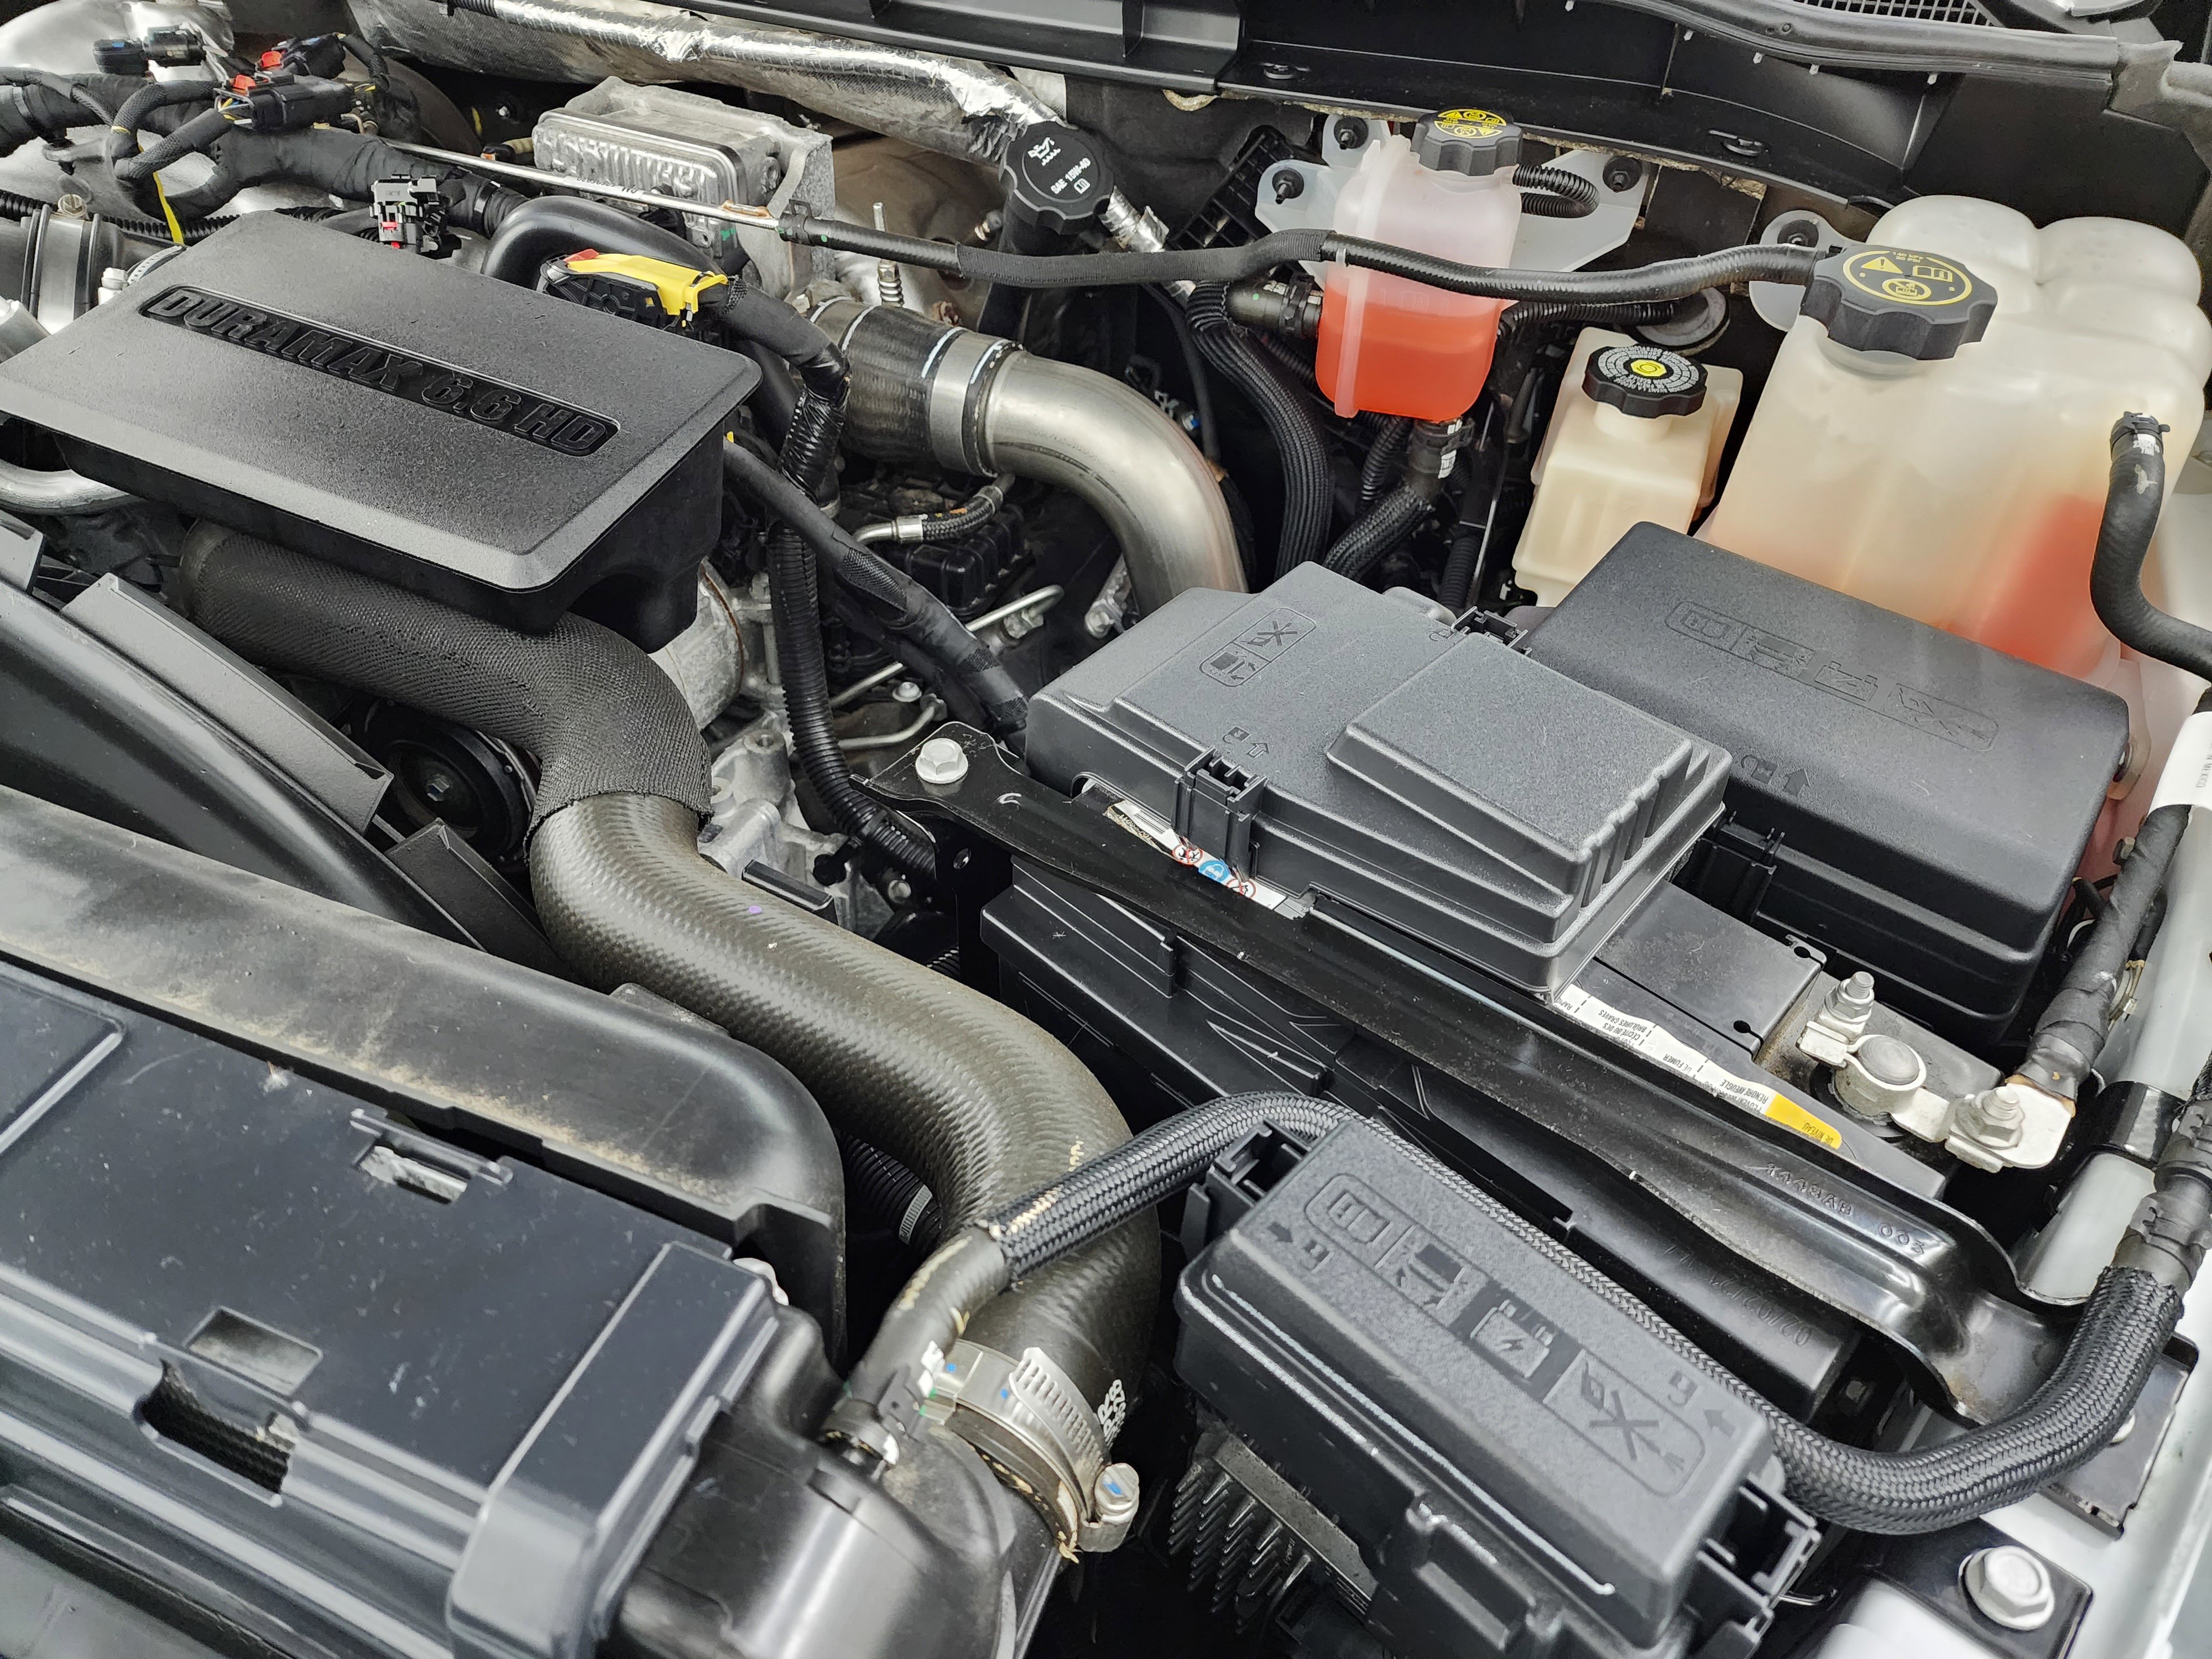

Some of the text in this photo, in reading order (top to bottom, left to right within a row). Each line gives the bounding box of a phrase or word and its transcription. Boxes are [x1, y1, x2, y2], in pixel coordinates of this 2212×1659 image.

[1051, 158, 1091, 194] SAE 15W-40
[148, 290, 607, 448] DURAMAX 6.6 HD
[1598, 1009, 1620, 1023] GRAVES
[1601, 1022, 1615, 1031] DES
[1662, 1053, 1684, 1068] FUMER
[1719, 1078, 1746, 1094] AVEUGLE
